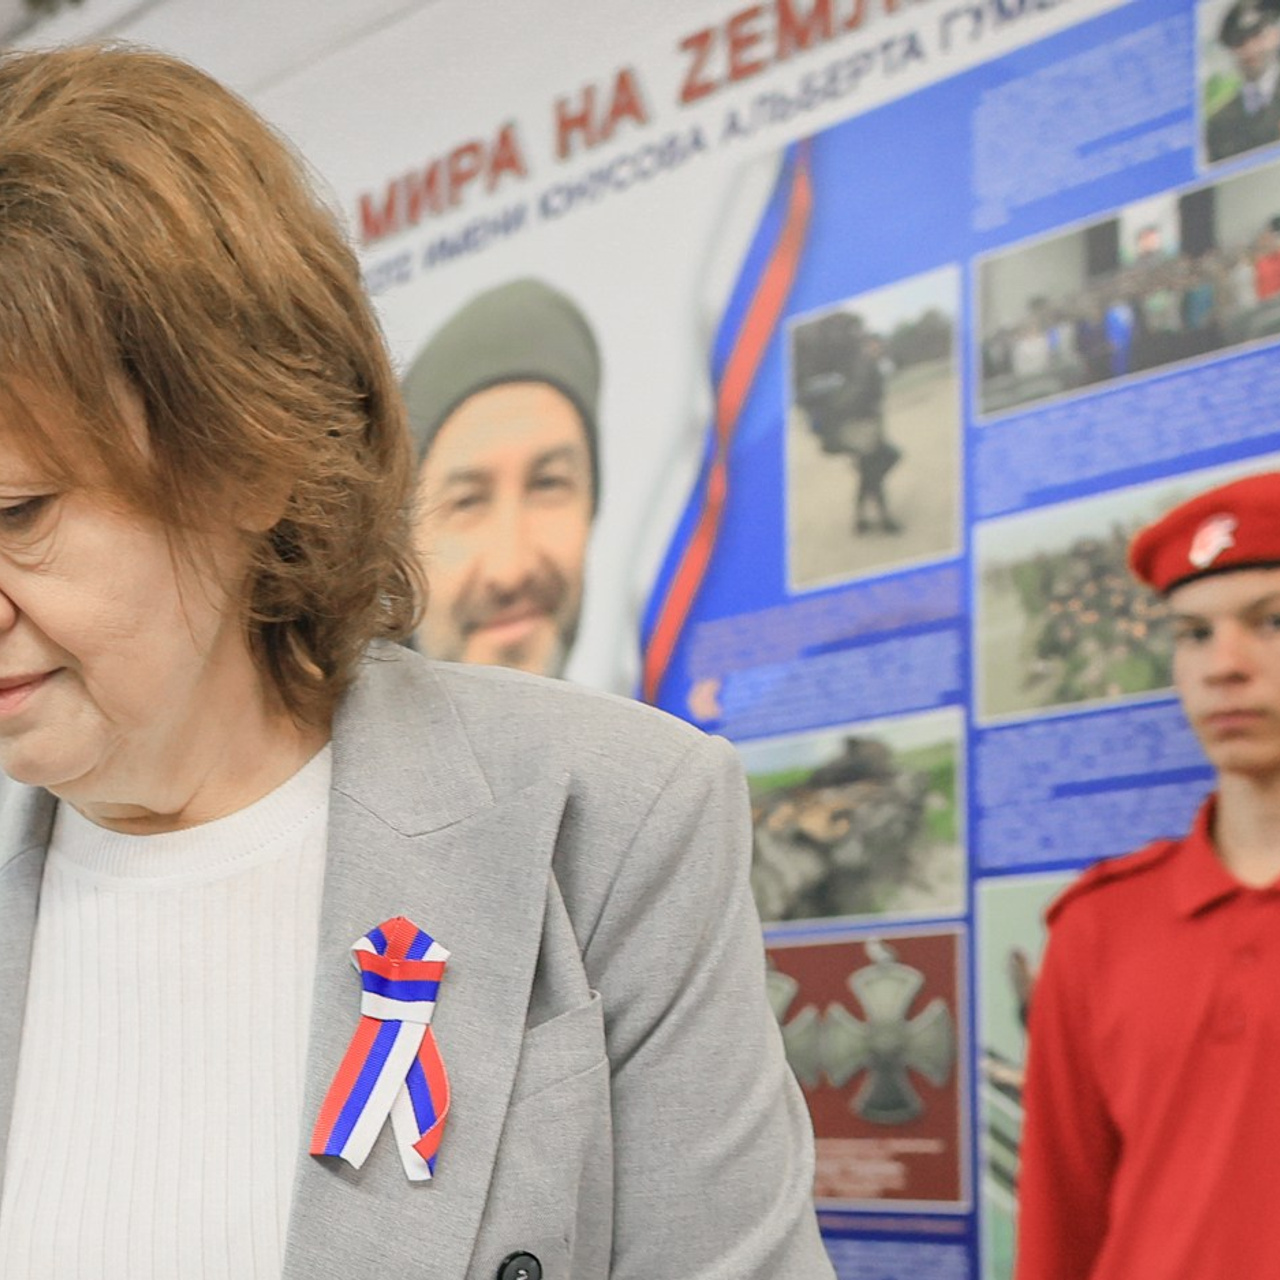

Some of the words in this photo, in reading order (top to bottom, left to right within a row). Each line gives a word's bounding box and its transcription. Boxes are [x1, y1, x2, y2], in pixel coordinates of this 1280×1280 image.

[356, 122, 528, 246] МИРА
[553, 66, 649, 162] НА
[422, 200, 528, 270] ИМЕНИ
[721, 30, 926, 143] АЛЬБЕРТА
